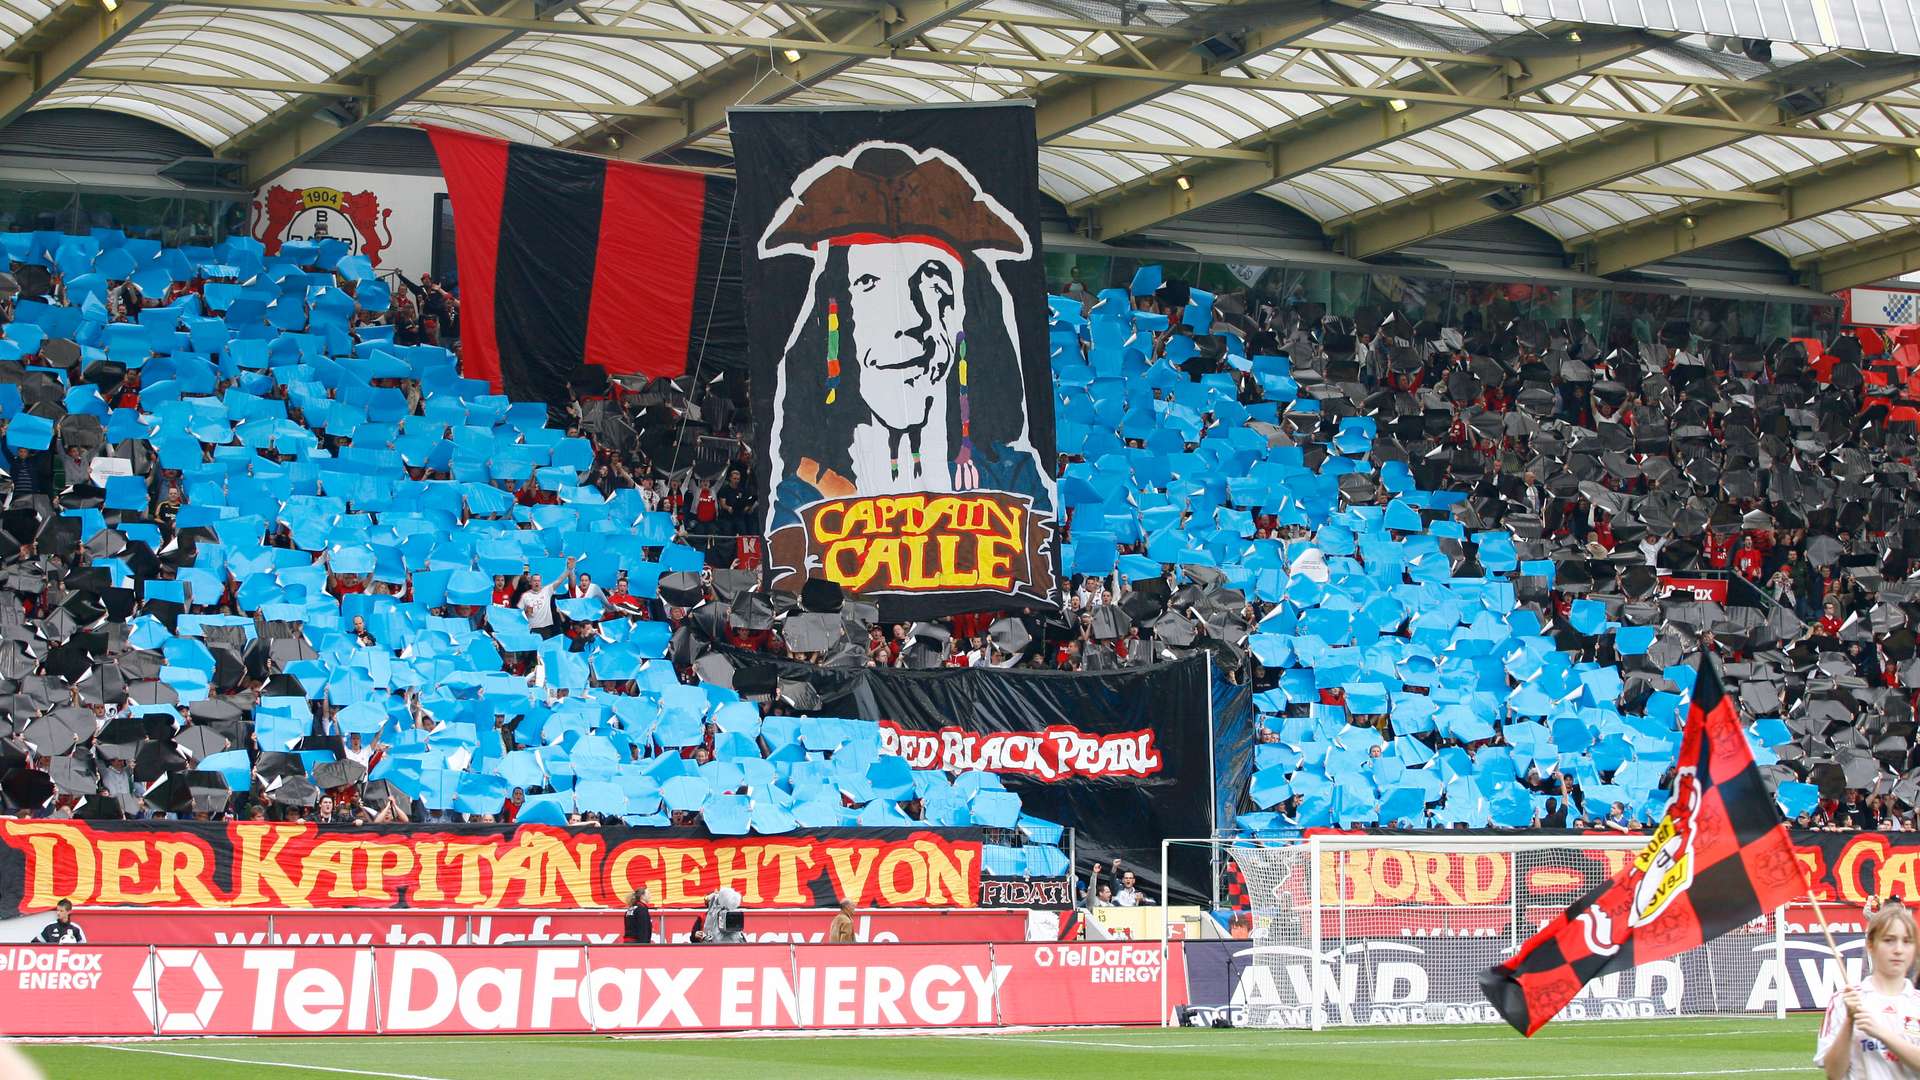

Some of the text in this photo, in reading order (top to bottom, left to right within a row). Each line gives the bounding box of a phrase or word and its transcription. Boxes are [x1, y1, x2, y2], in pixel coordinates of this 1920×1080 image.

[306, 191, 338, 204] 1904
[815, 496, 1024, 553] CAPTAIN
[825, 535, 1013, 590] CALLE
[942, 731, 1056, 778] BLACK
[1050, 731, 1158, 773] PEARL
[3, 822, 230, 908] DER
[610, 844, 815, 905] GEHT
[827, 839, 979, 908] VON
[1312, 848, 1507, 906] BORD
[1057, 946, 1161, 967] TelDaFax
[19, 972, 103, 989] ENERGY
[1091, 967, 1161, 983] ENERGY
[1231, 963, 1430, 1005] AWD
[243, 949, 1013, 1031] TelDaFax ENERGY
[1269, 1007, 1328, 1024] AWD
[1369, 1007, 1425, 1023] AWD
[1444, 1006, 1501, 1021] AWD
[1601, 1005, 1656, 1017] AWD
